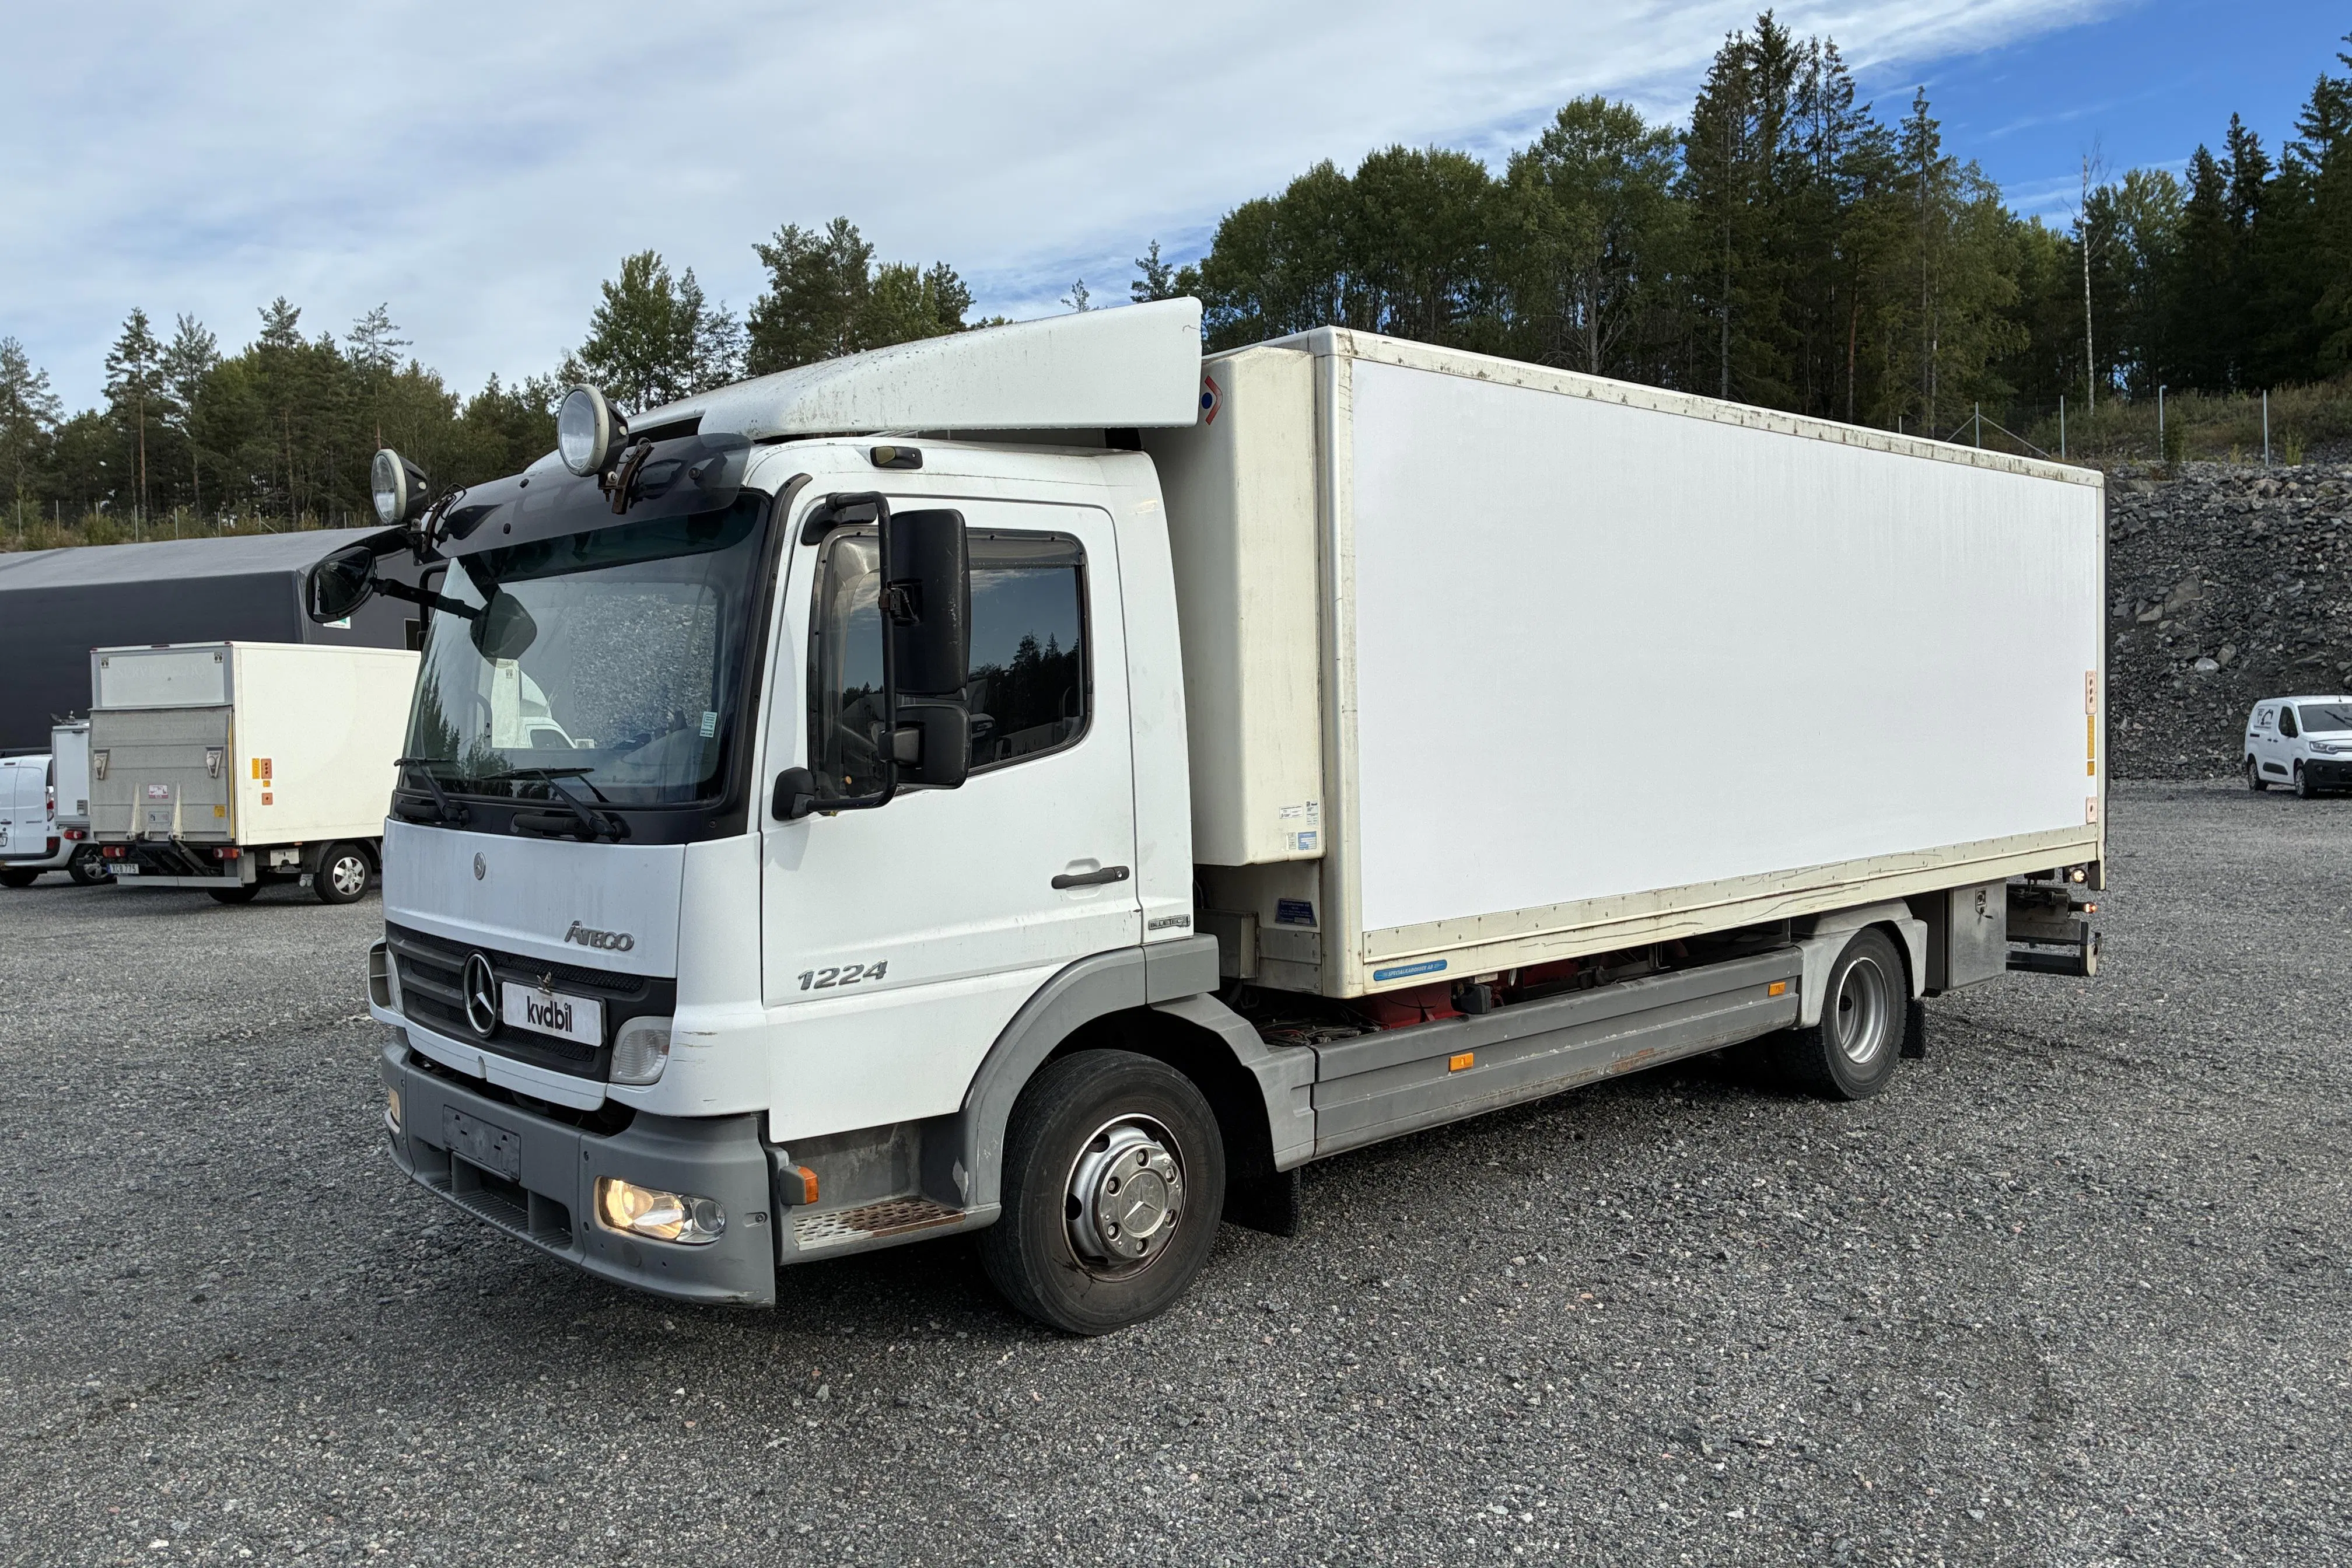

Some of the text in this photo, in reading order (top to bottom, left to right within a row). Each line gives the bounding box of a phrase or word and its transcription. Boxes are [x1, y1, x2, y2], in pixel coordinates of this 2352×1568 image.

[125, 864, 136, 873] 775
[564, 921, 635, 951] ATEGO
[798, 959, 888, 990] 1224
[527, 995, 572, 1032] kvdbil
